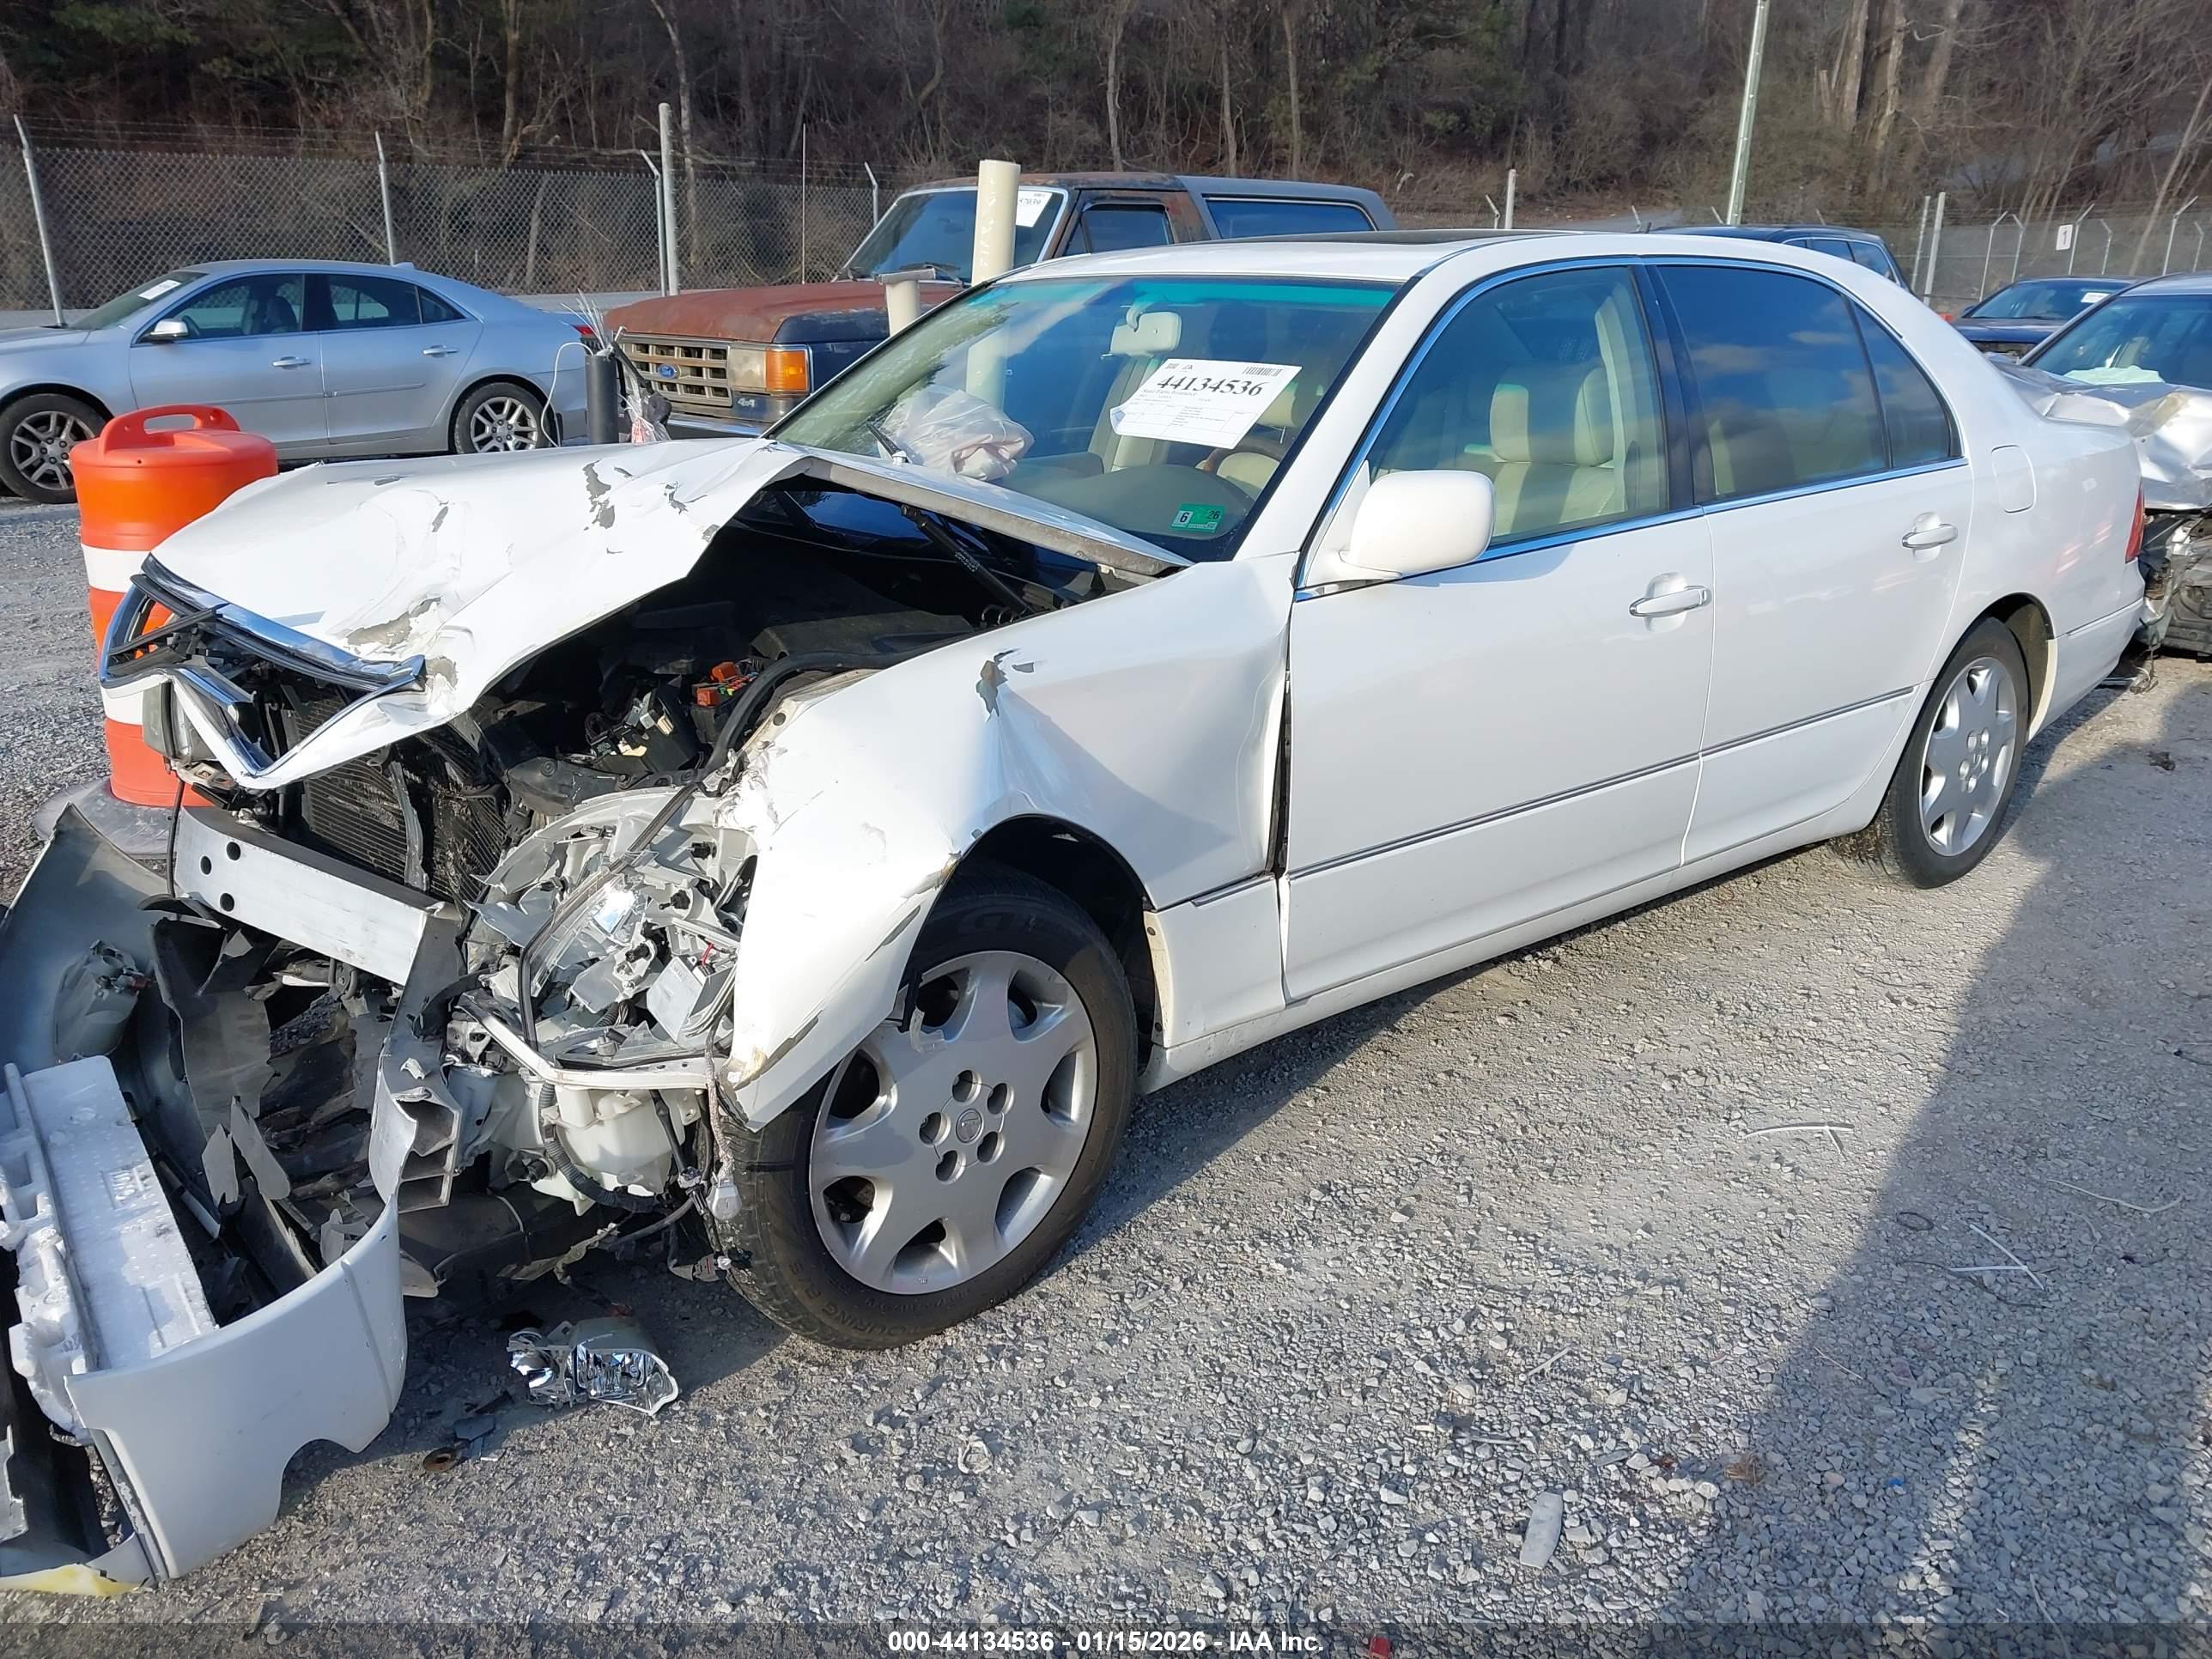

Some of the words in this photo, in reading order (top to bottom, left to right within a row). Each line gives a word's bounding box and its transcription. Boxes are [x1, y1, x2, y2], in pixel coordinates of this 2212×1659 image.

[2063, 229, 2068, 246] 1
[1158, 375, 1269, 397] 44134536
[1179, 512, 1190, 523] 6
[1206, 510, 1221, 520] 26
